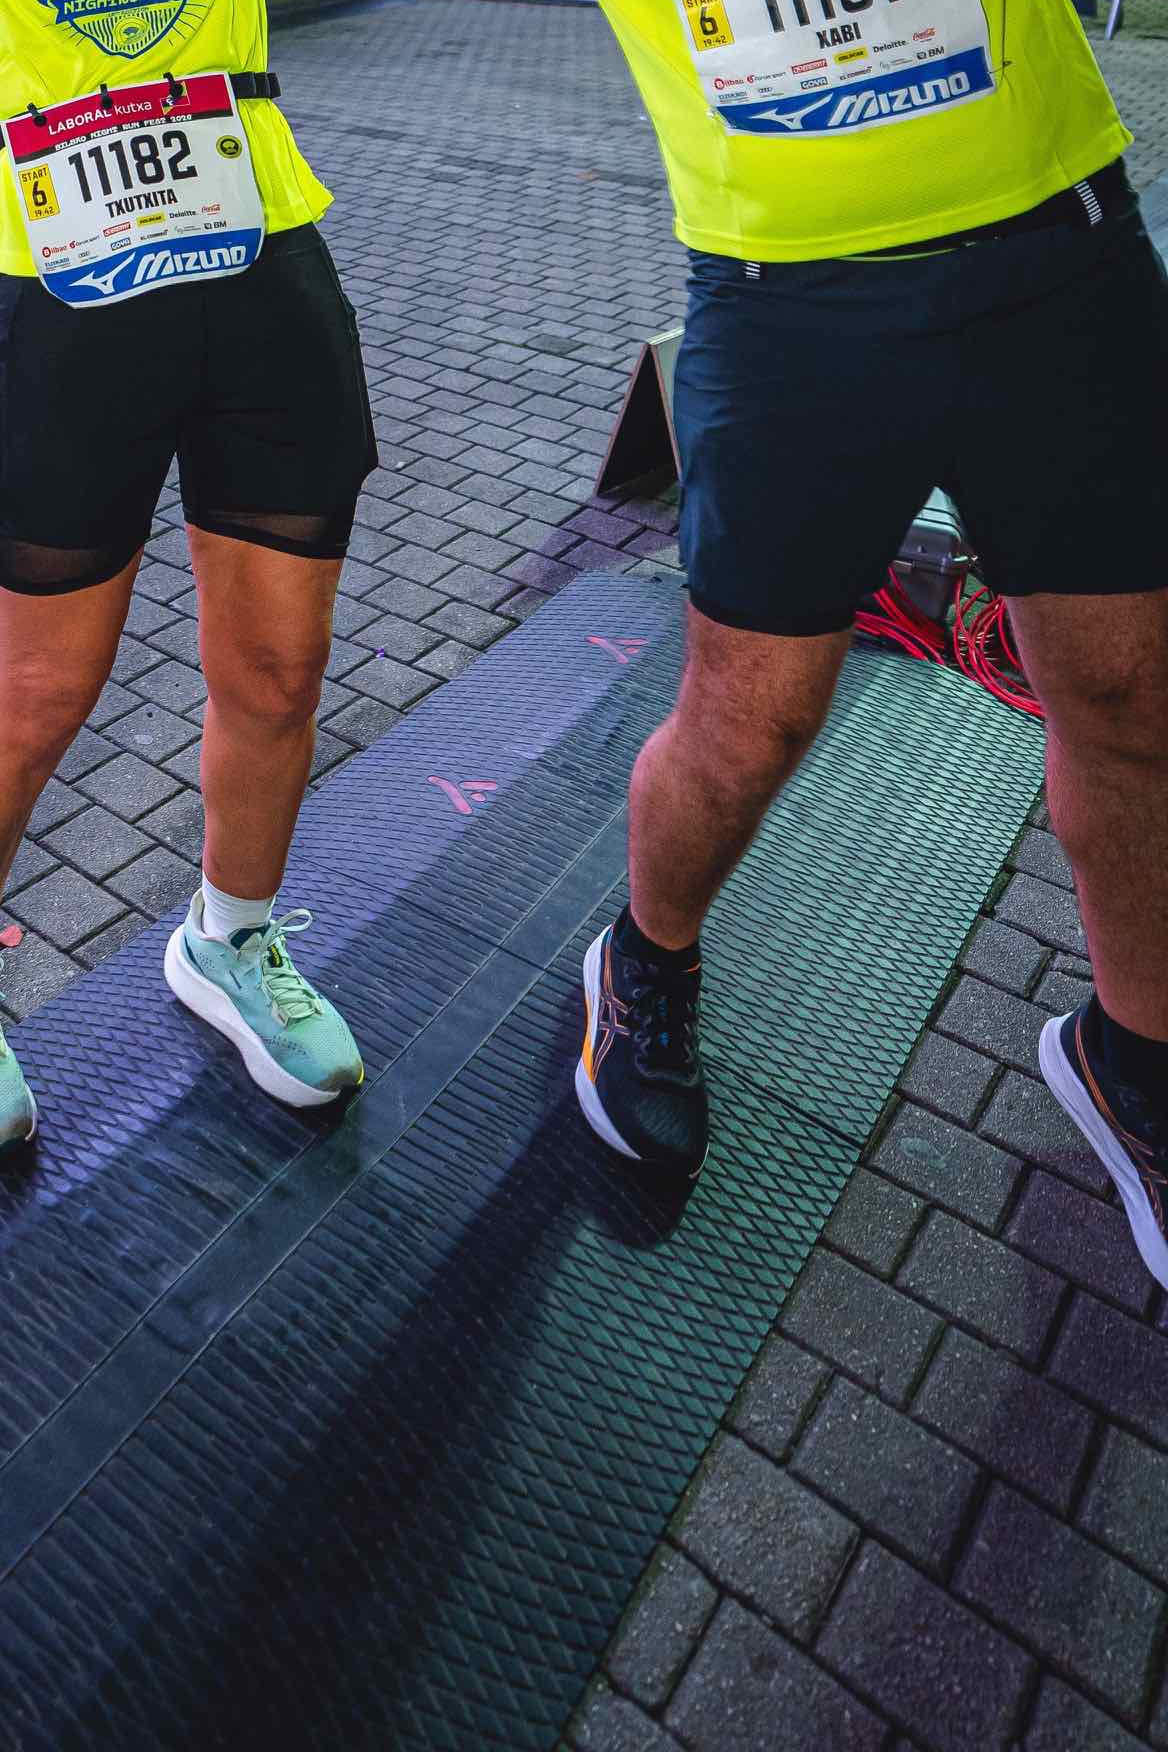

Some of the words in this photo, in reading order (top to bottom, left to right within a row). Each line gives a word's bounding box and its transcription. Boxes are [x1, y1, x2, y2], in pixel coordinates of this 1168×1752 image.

[699, 6, 719, 37] 6
[815, 22, 863, 50] XABI
[827, 71, 970, 127] MIZUNO
[47, 108, 112, 136] LABORAL
[114, 100, 153, 116] kutxa
[21, 166, 48, 183] START
[67, 129, 199, 204] 11182
[32, 180, 48, 208] 6
[105, 188, 179, 219] TXUTXITA
[133, 245, 247, 286] MIZUNO
